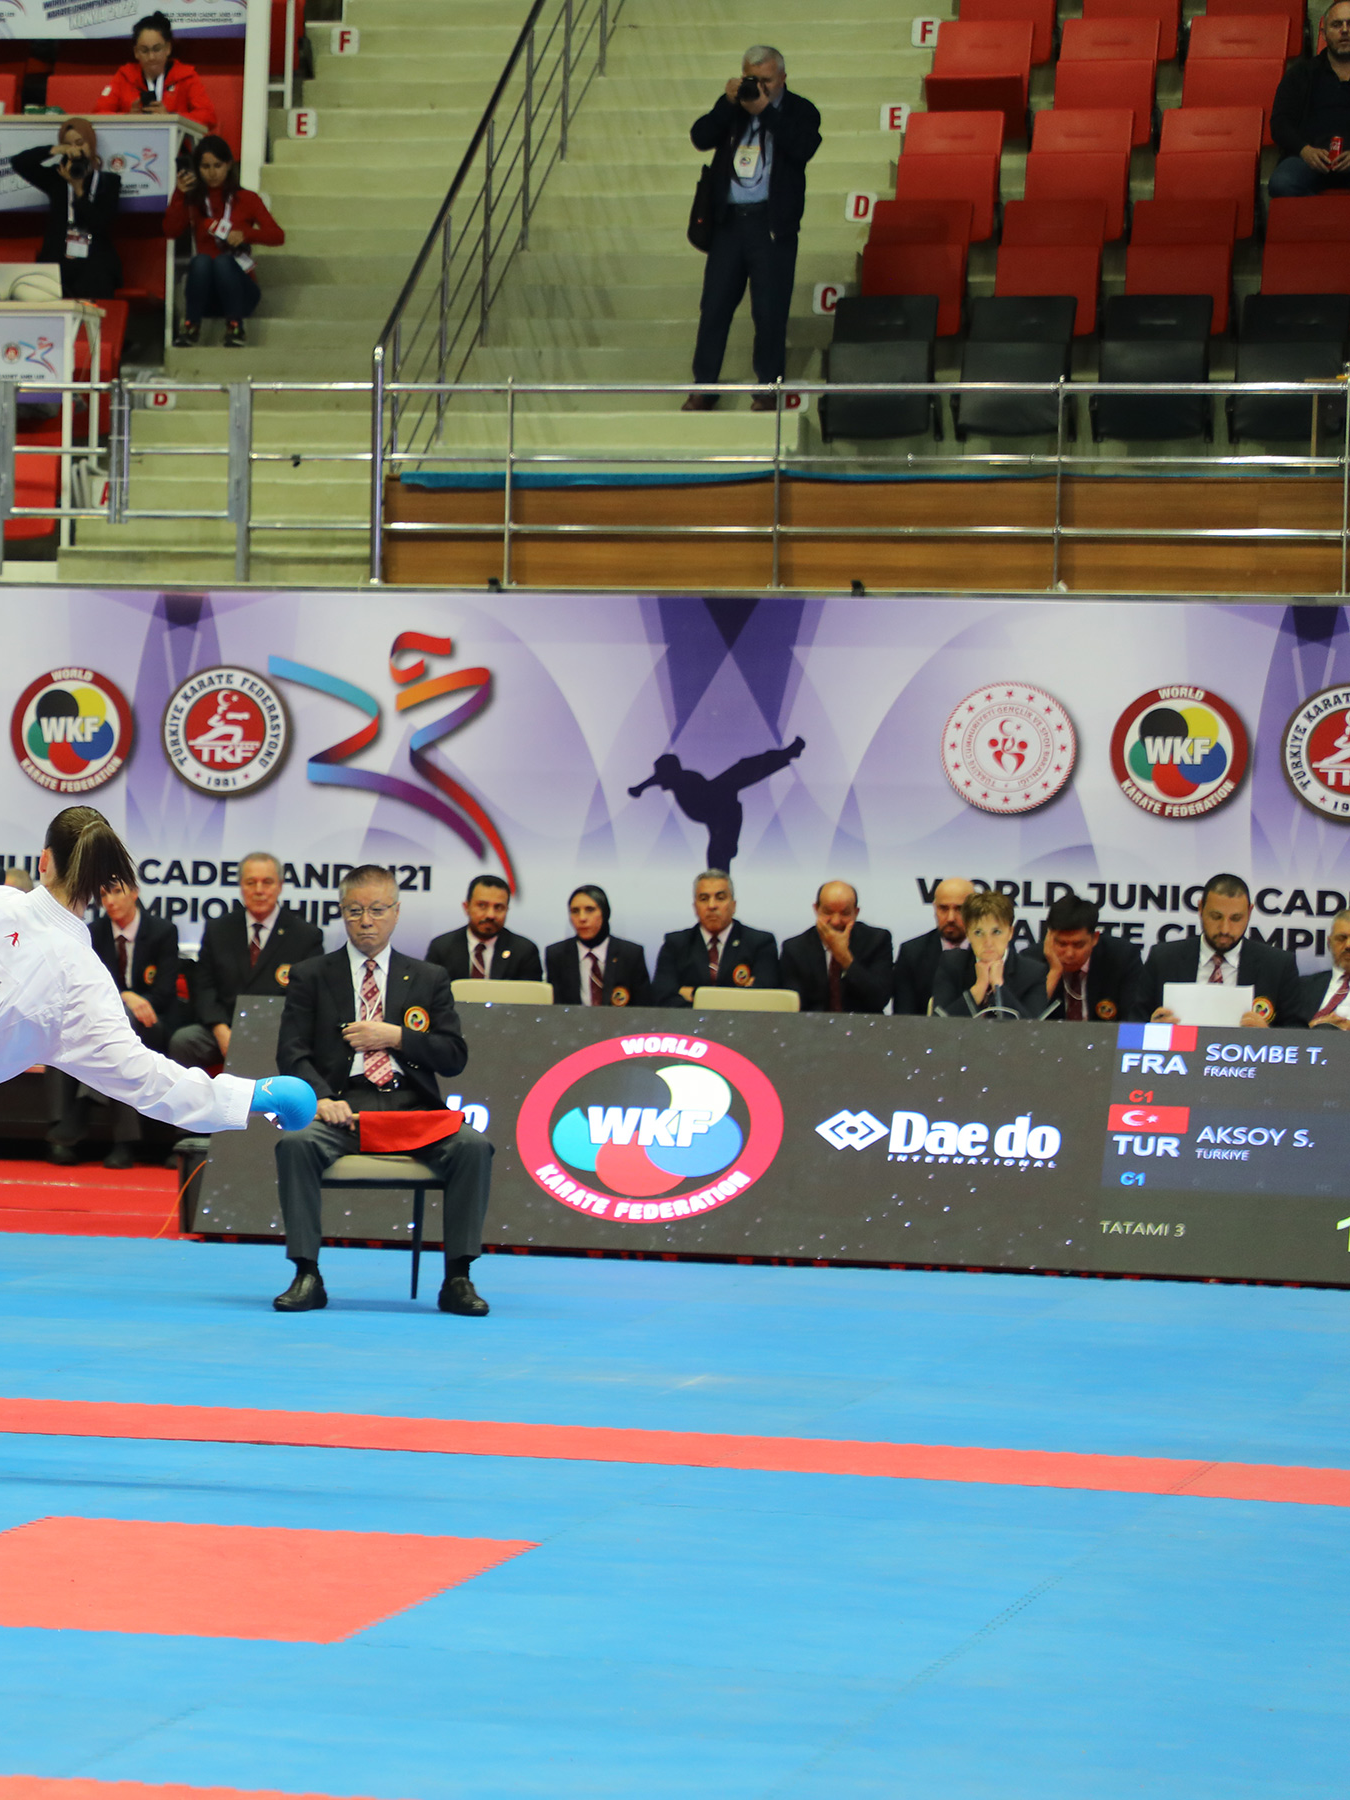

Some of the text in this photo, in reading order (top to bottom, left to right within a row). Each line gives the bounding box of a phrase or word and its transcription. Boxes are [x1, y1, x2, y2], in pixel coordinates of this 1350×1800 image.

[339, 31, 351, 53] F
[920, 21, 933, 44] F
[296, 113, 307, 136] E
[889, 106, 902, 131] E
[853, 196, 869, 219] D
[821, 287, 837, 313] C
[51, 668, 94, 681] WORLD
[1158, 687, 1206, 701] WORLD
[1303, 692, 1350, 723] KARAT
[40, 716, 100, 743] WKF
[181, 674, 234, 703] KARATE
[241, 677, 281, 768] FEDERASYONU
[194, 746, 254, 763] TKF
[1144, 736, 1211, 765] WKF
[20, 755, 123, 792] KARATE FEDERATION
[1121, 778, 1236, 817] KARATE FEDERATION
[138, 859, 242, 887] CADE
[388, 865, 431, 891] 21
[1255, 888, 1350, 917] CAD
[620, 1036, 708, 1059] WORLD
[1121, 1043, 1328, 1075] FRA SOMBE T.
[1203, 1065, 1257, 1079] FRANCE
[1129, 1089, 1154, 1104] C1
[587, 1105, 714, 1147] WKF
[1112, 1126, 1316, 1158] TUR AKSOY S.
[887, 1153, 1058, 1169] INTERNATIONAL
[535, 1163, 751, 1220] KARATE FEDERATION
[1119, 1171, 1146, 1187] C1
[1100, 1220, 1186, 1238] TATAMI 3
